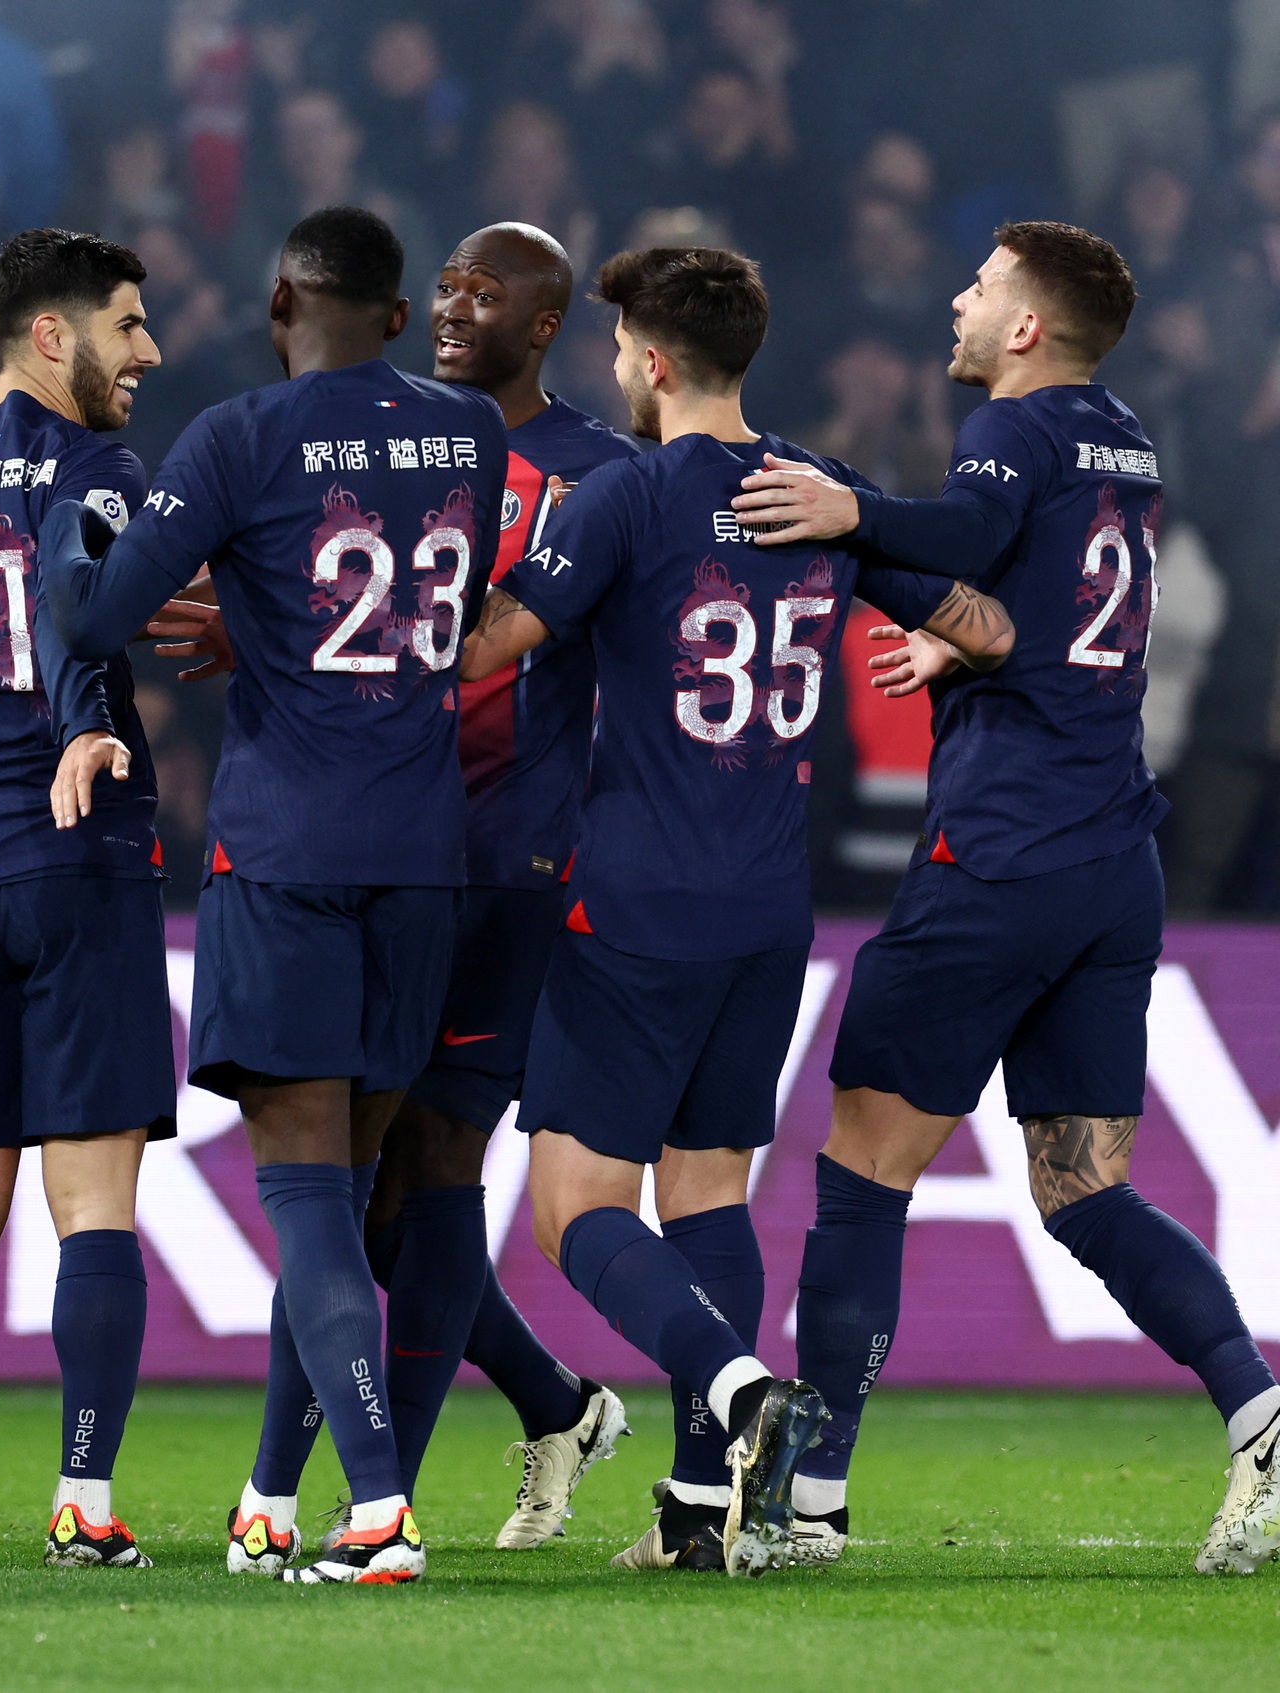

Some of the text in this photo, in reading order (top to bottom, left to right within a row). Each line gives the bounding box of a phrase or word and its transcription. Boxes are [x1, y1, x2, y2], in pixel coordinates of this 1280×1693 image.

[945, 458, 1019, 483] OAT
[143, 488, 186, 517] AT
[524, 542, 572, 577] AT
[311, 526, 471, 672] 23
[675, 597, 836, 744] 35
[351, 1357, 387, 1430] PARIS
[857, 1333, 889, 1395] PARIS
[70, 1408, 96, 1469] PARIS
[689, 1392, 709, 1435] PAR
